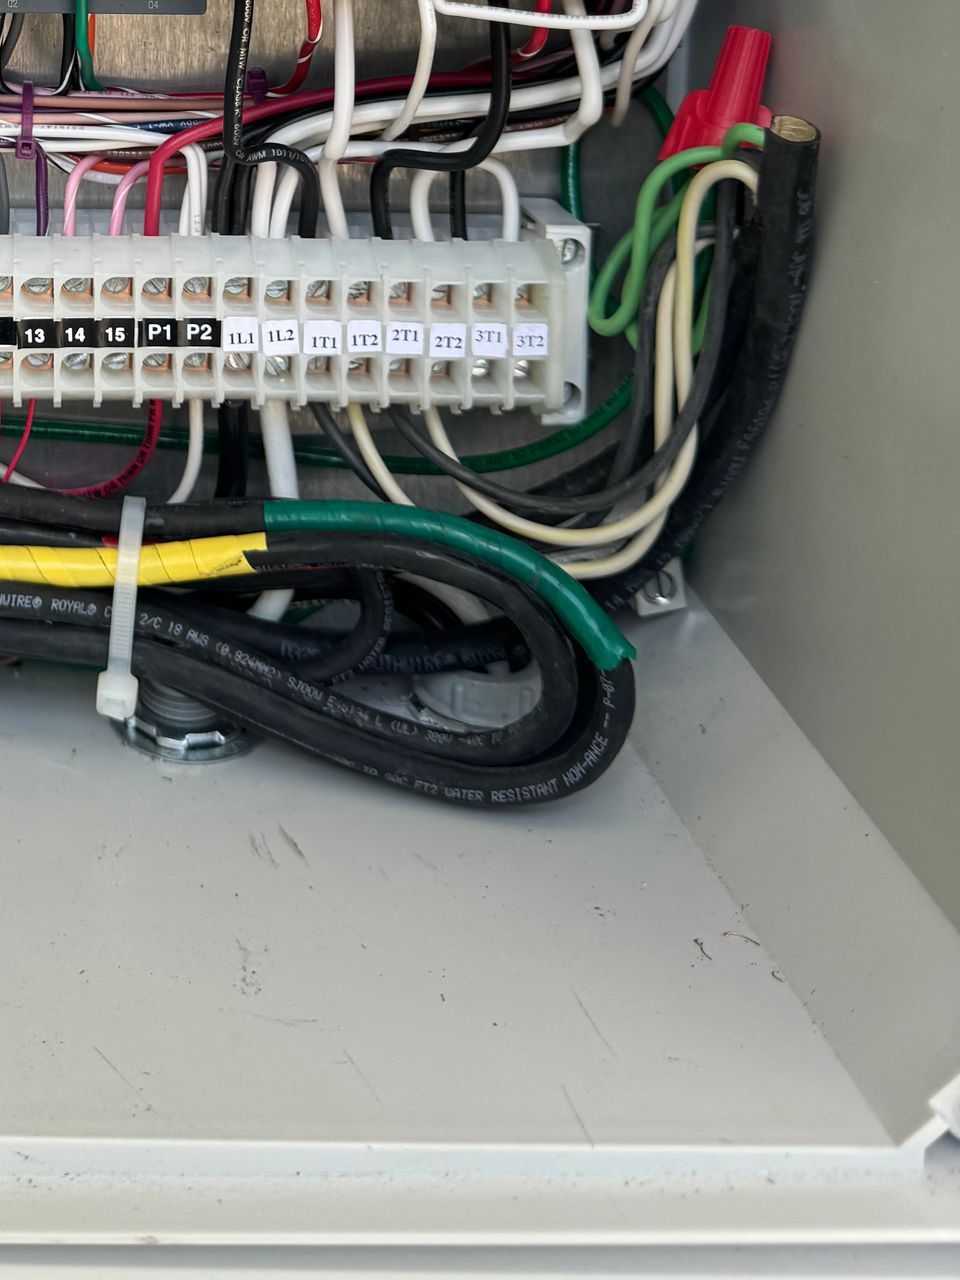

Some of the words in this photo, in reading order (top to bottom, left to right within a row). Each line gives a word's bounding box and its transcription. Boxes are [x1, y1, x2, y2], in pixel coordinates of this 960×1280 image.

[24, 328, 45, 343] 13
[65, 327, 86, 343] 14
[105, 327, 125, 342] 15
[148, 324, 172, 340] P1
[186, 324, 212, 340] P2
[228, 332, 254, 345] 1L1
[268, 329, 294, 342] 1L2
[391, 329, 419, 342] 2T1
[475, 330, 502, 343] 3T1
[311, 336, 337, 349] 1T1
[351, 334, 378, 347] 1T2
[434, 335, 462, 349] 2T2
[516, 334, 544, 348] 3T2
[444, 787, 484, 802] WATER
[491, 779, 560, 803] RESISTANT
